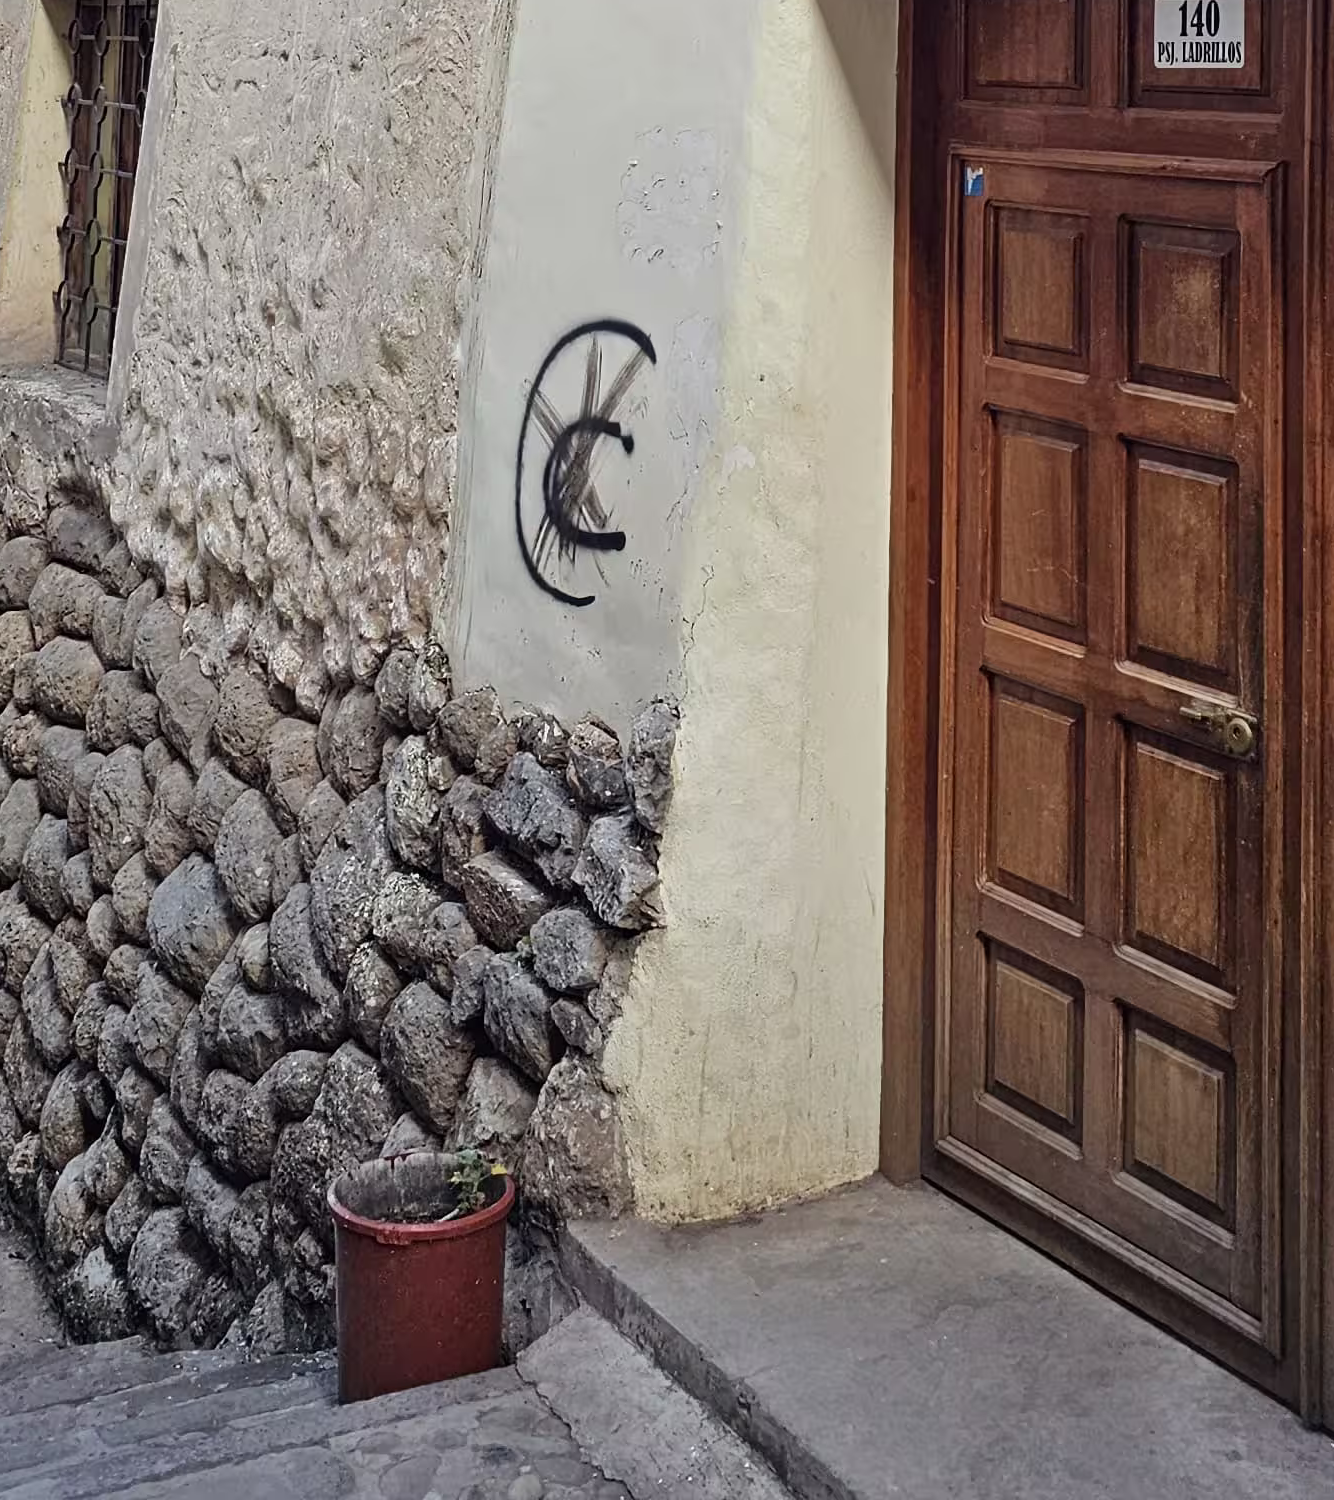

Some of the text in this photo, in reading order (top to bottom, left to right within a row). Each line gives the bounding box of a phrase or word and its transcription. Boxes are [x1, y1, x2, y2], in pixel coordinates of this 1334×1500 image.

[1178, 0, 1221, 37] 140
[1157, 41, 1242, 66] PSJ. LADRILLOS
